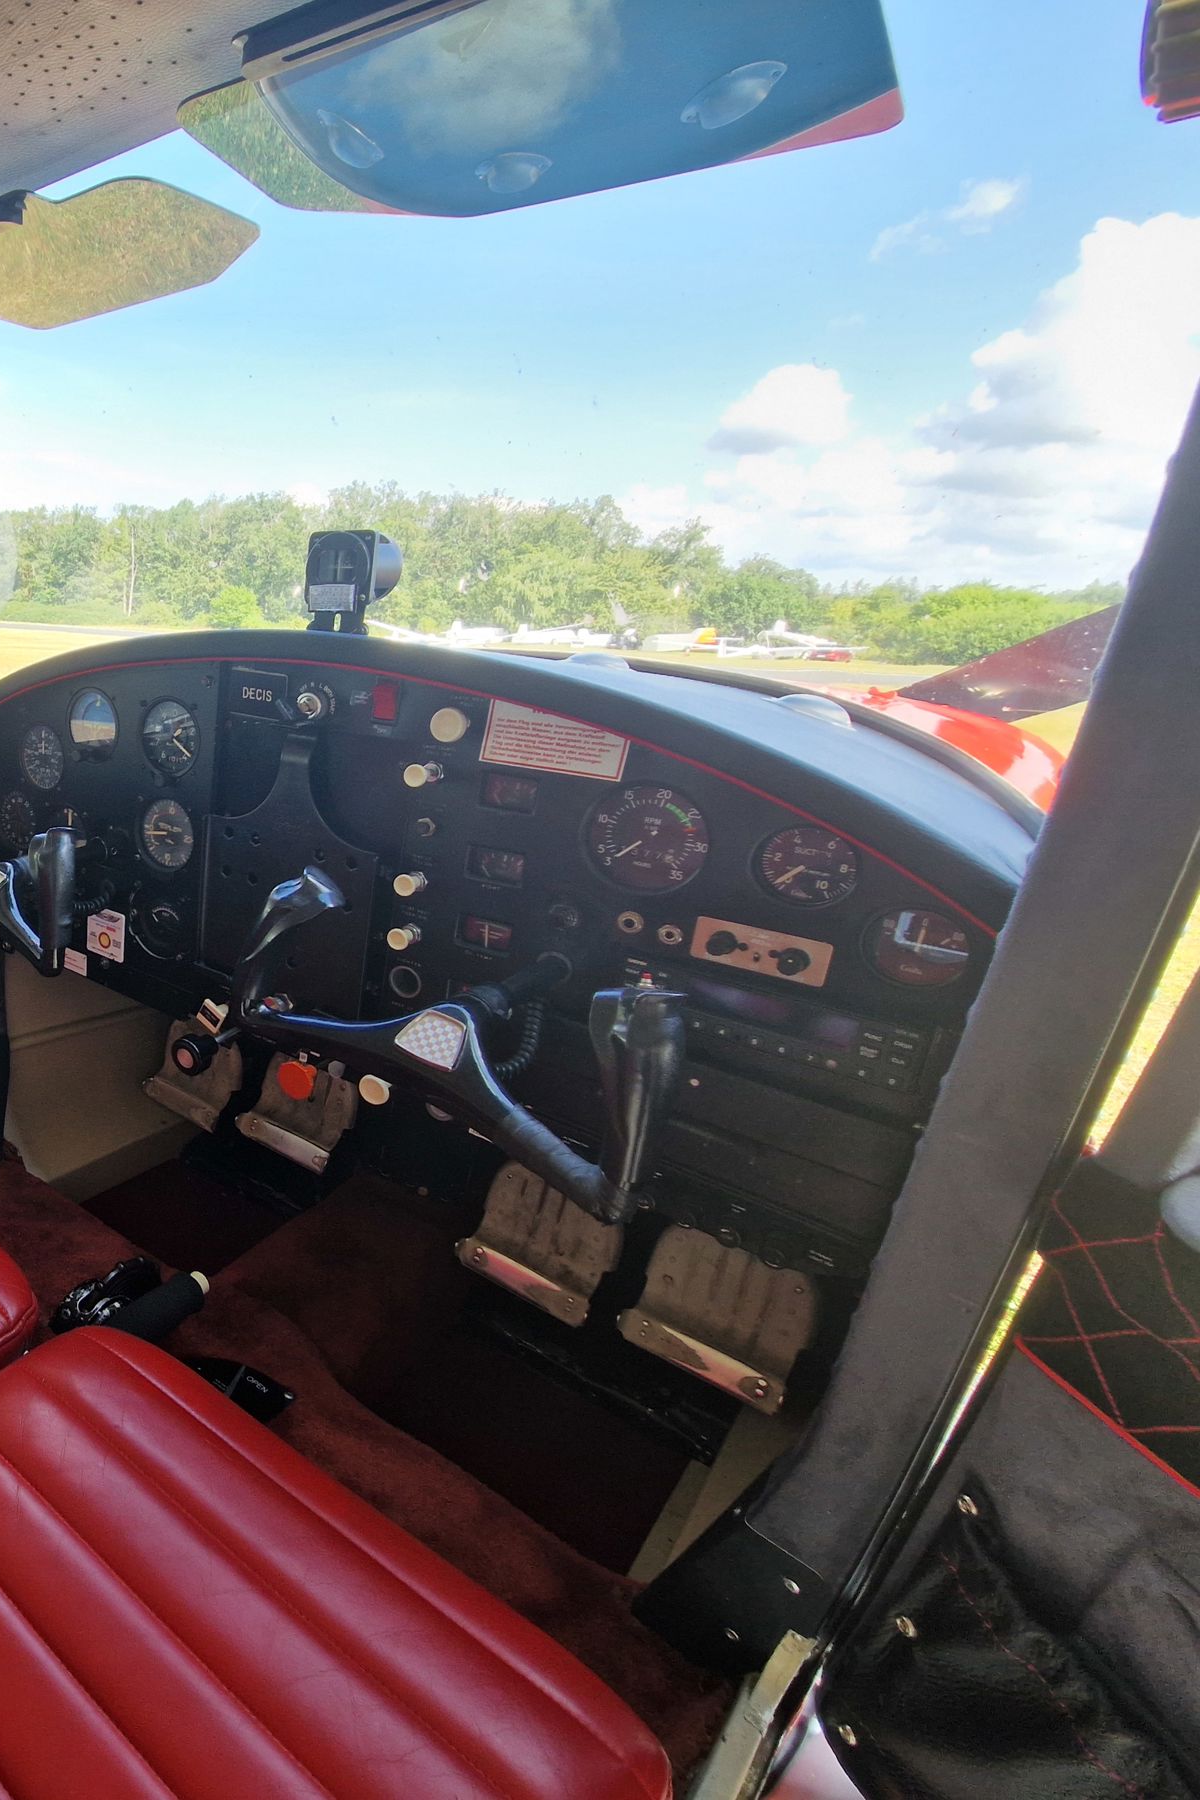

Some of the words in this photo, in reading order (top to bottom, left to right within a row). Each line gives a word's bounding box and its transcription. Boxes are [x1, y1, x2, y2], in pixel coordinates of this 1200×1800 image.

[242, 686, 273, 702] DECIS
[624, 790, 634, 800] 15
[656, 788, 672, 799] 20
[598, 814, 608, 823] 10
[644, 816, 662, 826] RPM
[597, 844, 606, 854] 5
[693, 842, 709, 853] 30
[827, 841, 836, 850] 6
[603, 857, 612, 866] 3
[773, 852, 782, 862] 2
[839, 864, 849, 873] 8
[668, 870, 684, 881] 35
[816, 880, 829, 889] 10
[246, 1375, 269, 1393] OPEN
